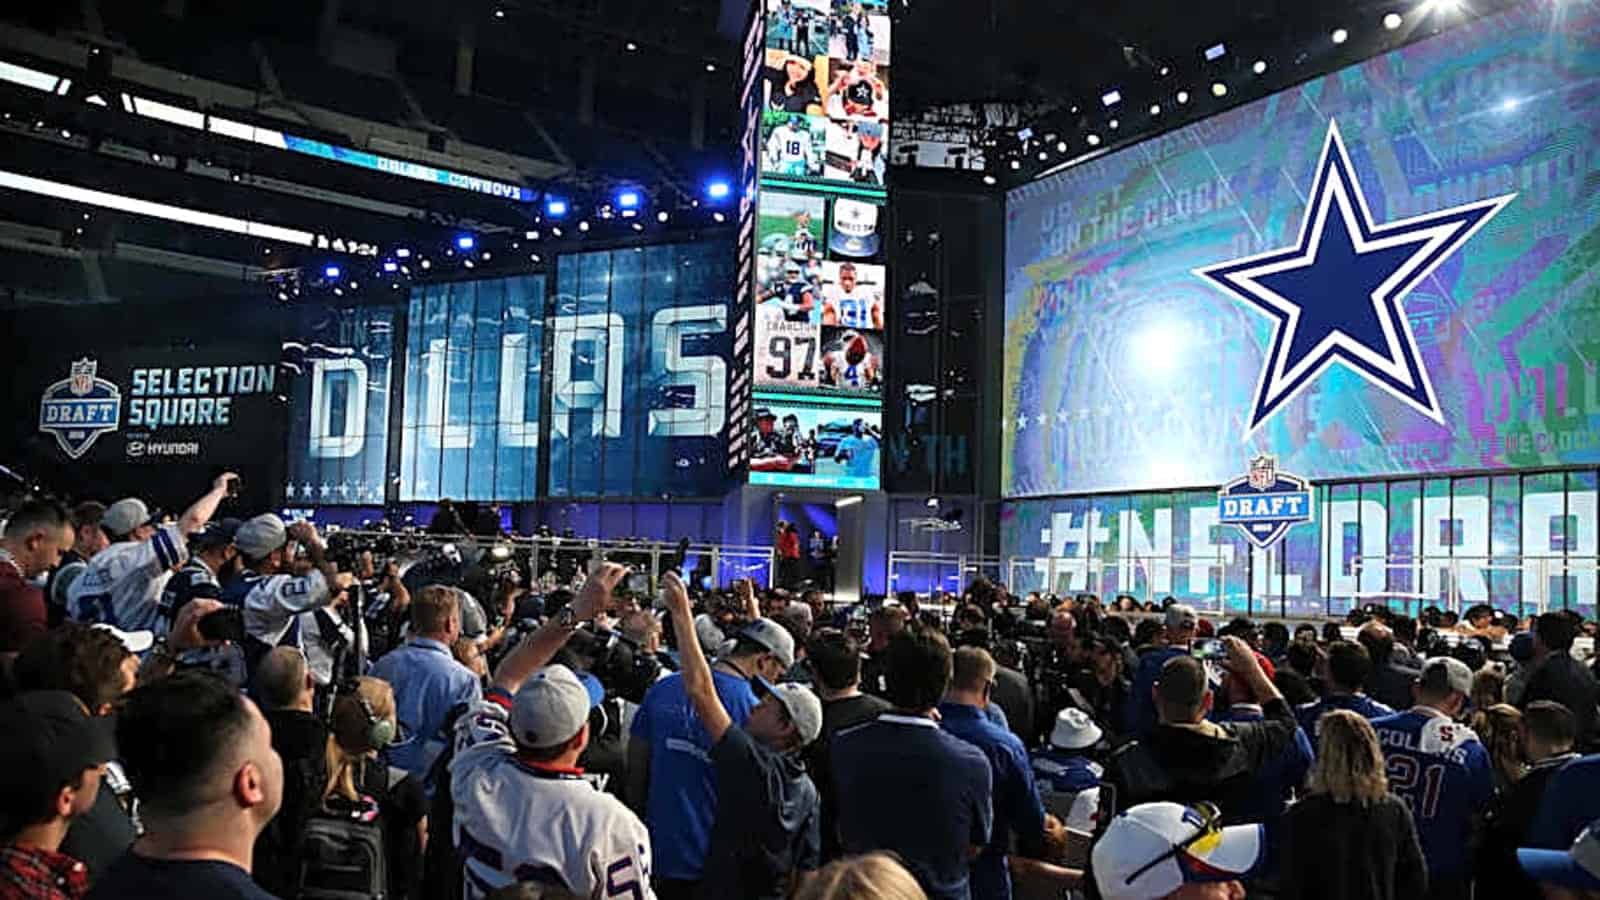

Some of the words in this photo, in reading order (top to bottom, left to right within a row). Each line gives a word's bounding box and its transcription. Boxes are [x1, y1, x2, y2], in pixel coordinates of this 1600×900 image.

[765, 335, 817, 381] 97
[132, 364, 277, 395] SELECTION
[309, 303, 728, 459] DLLAS
[46, 403, 114, 422] DRAFT
[129, 396, 233, 430] SQUARE
[147, 441, 199, 456] HYUNDAI
[1223, 496, 1302, 516] DRAFT
[1384, 752, 1446, 818] 21
